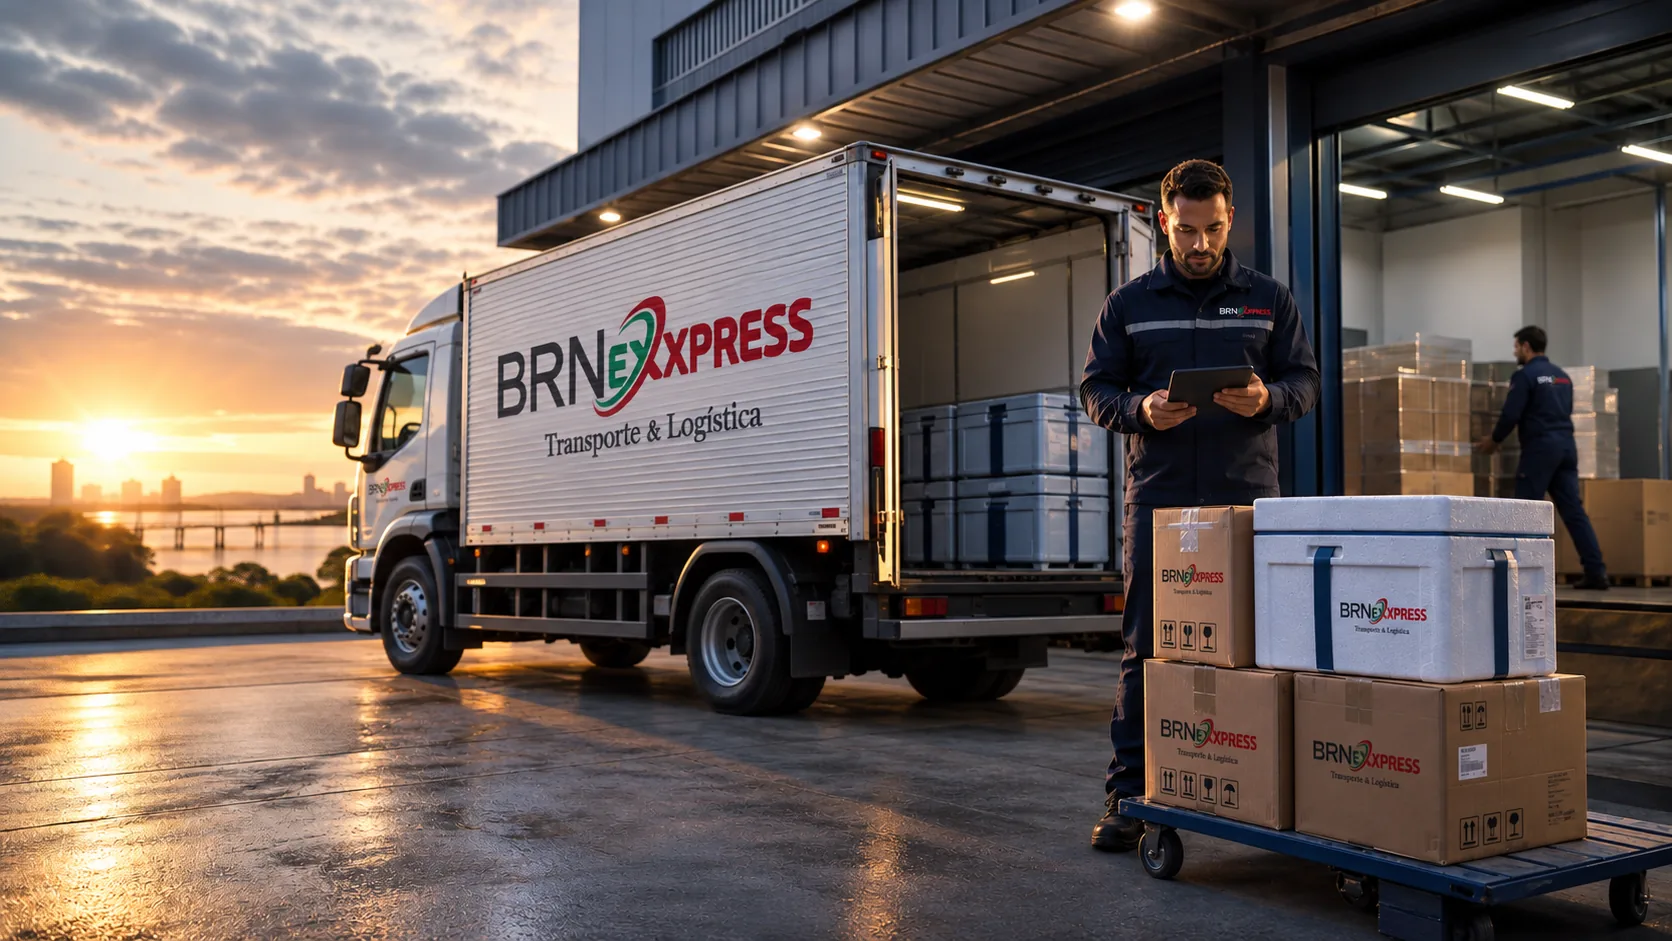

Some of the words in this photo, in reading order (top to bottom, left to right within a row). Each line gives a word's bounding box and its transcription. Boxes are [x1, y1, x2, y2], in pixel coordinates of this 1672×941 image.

[545, 422, 641, 457] Transporte
[647, 420, 661, 443] &
[667, 401, 763, 442] Logística
